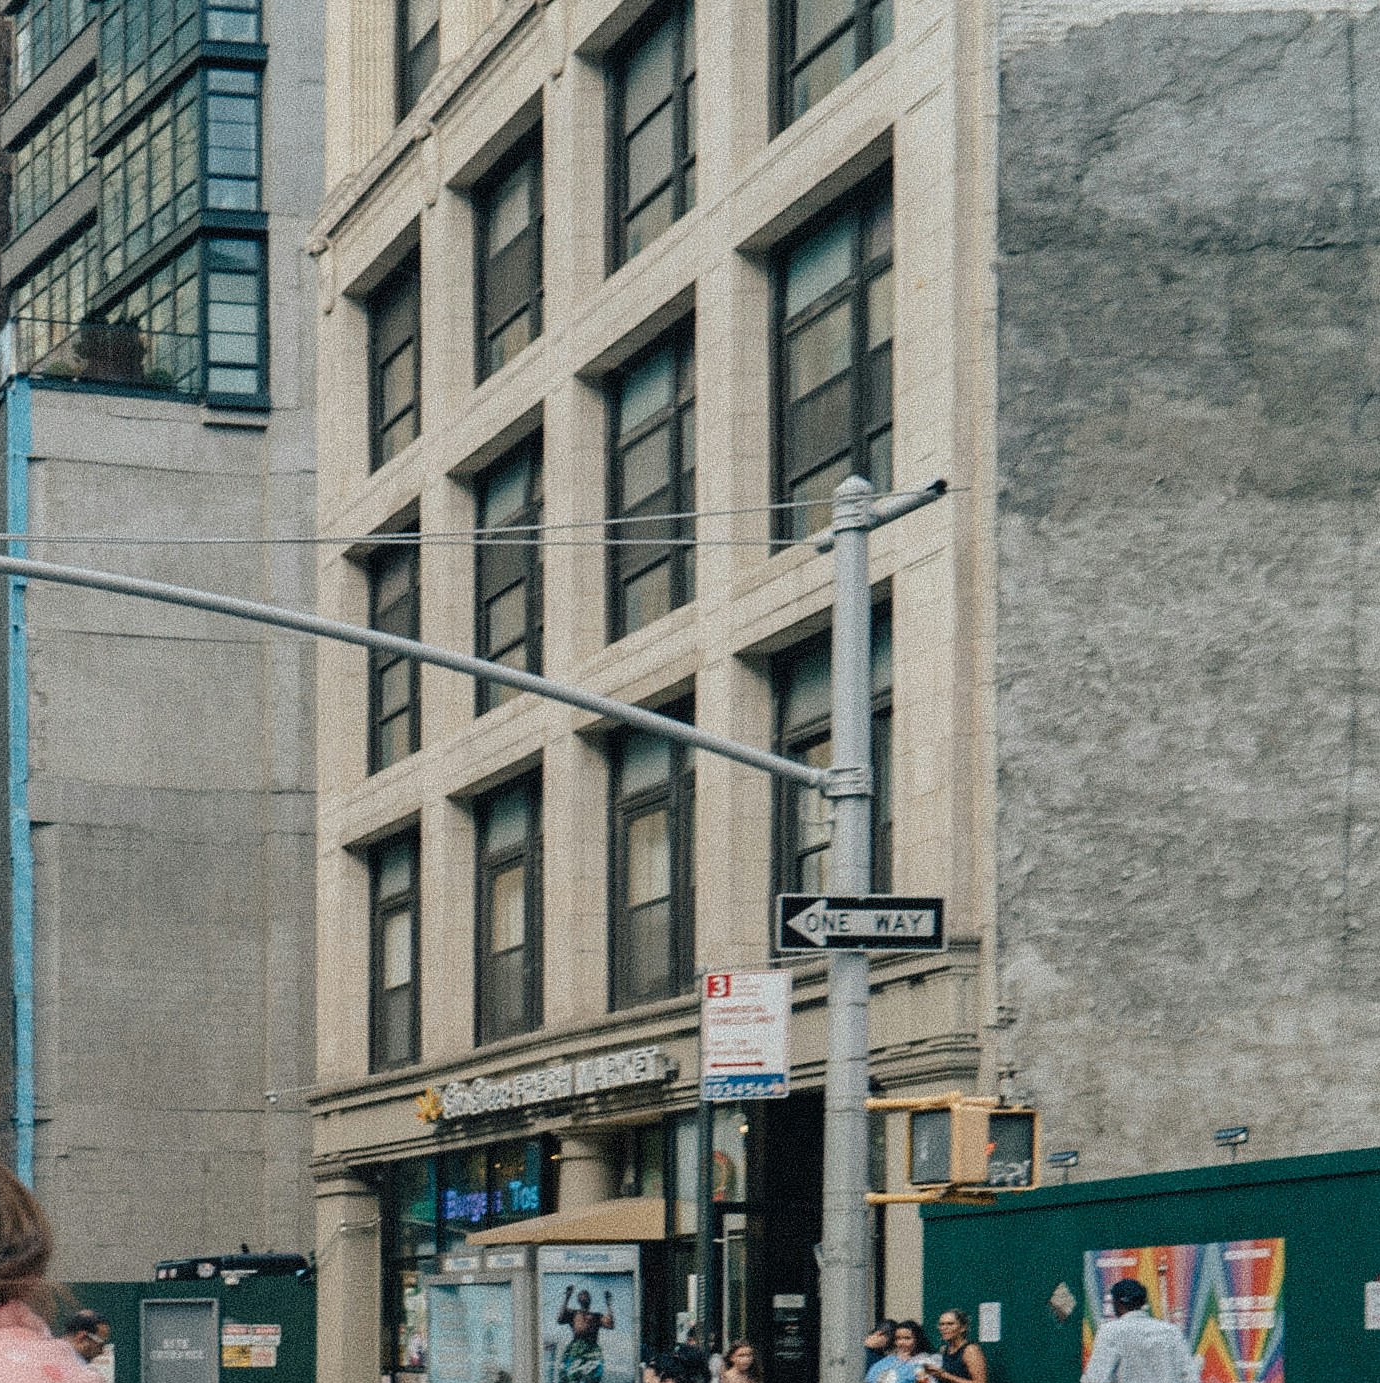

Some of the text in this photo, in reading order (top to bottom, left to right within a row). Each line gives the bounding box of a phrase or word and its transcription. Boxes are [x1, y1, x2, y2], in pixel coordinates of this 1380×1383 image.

[804, 912, 925, 933] ONE WAY
[711, 975, 727, 998] 3
